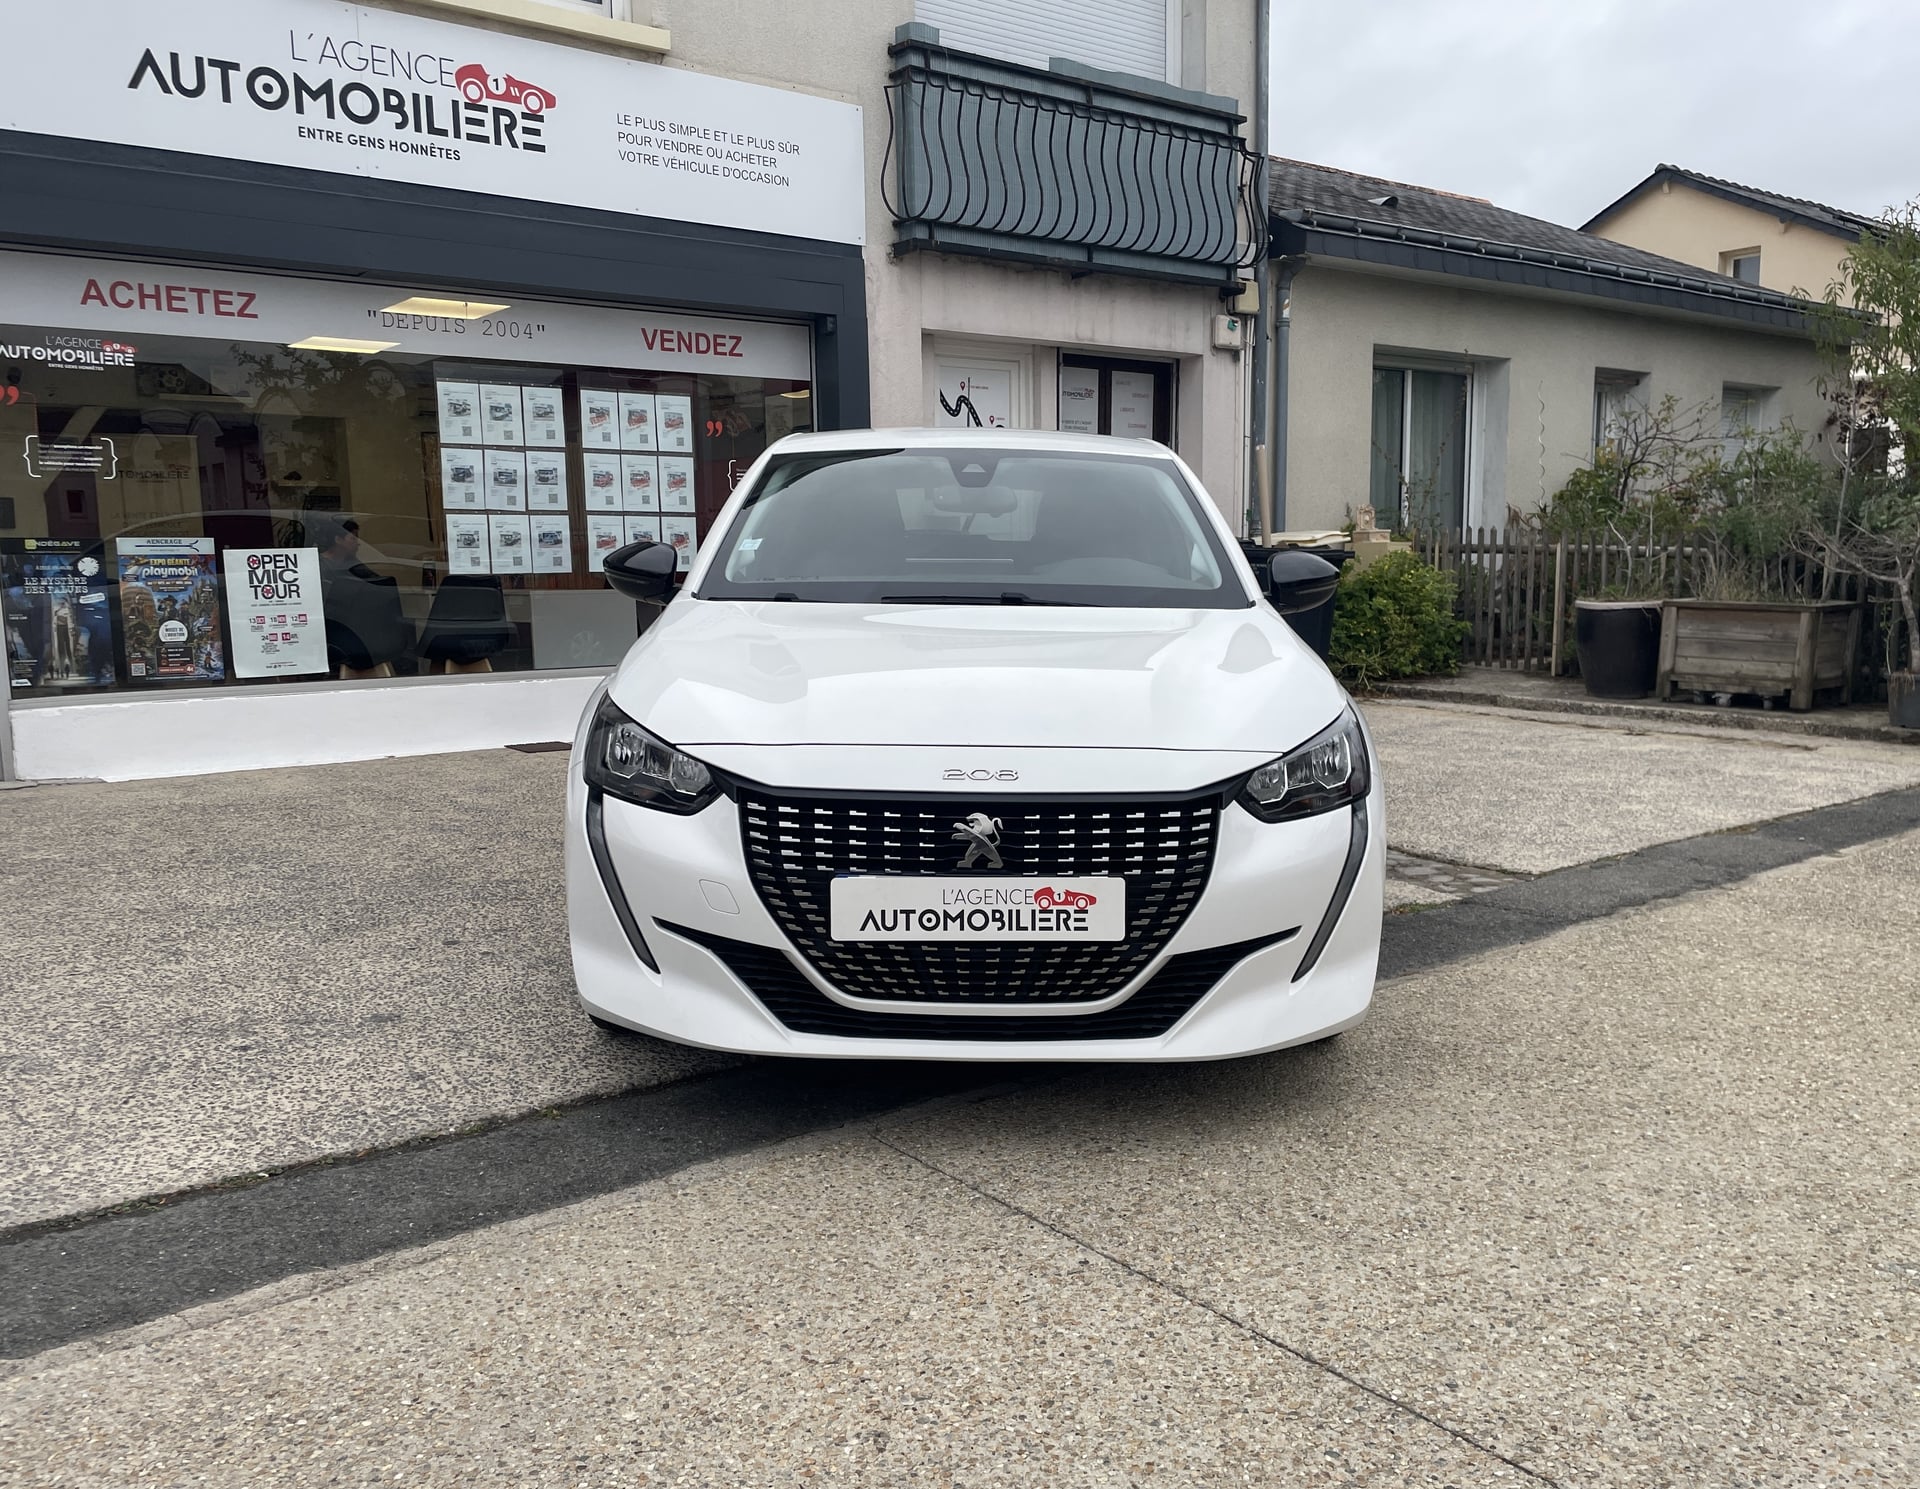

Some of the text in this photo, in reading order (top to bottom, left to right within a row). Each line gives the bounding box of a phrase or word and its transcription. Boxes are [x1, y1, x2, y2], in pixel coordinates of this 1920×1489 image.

[290, 29, 456, 88] L'AGENCE
[298, 125, 461, 161] ENTRE GENS HONNÊTES
[616, 113, 800, 156] LE PLUS SIMPLE ET LE PLUS SÛR
[617, 131, 777, 168] POUR VENDRE OU ACHETER
[618, 149, 790, 187] VOTRE VÉHICULE D'OCCASION
[80, 278, 260, 319] ACHETEZ
[45, 336, 102, 349] L'AGENCE
[640, 327, 743, 358] VENDEZ
[247, 553, 298, 570] OPEN
[142, 566, 199, 578] playmobil
[248, 568, 299, 585] MIC
[24, 577, 38, 586] LE
[24, 586, 45, 594] DES
[249, 584, 301, 600] TOUR
[942, 768, 1019, 782] 208
[942, 887, 1034, 905] L'AGENCE
